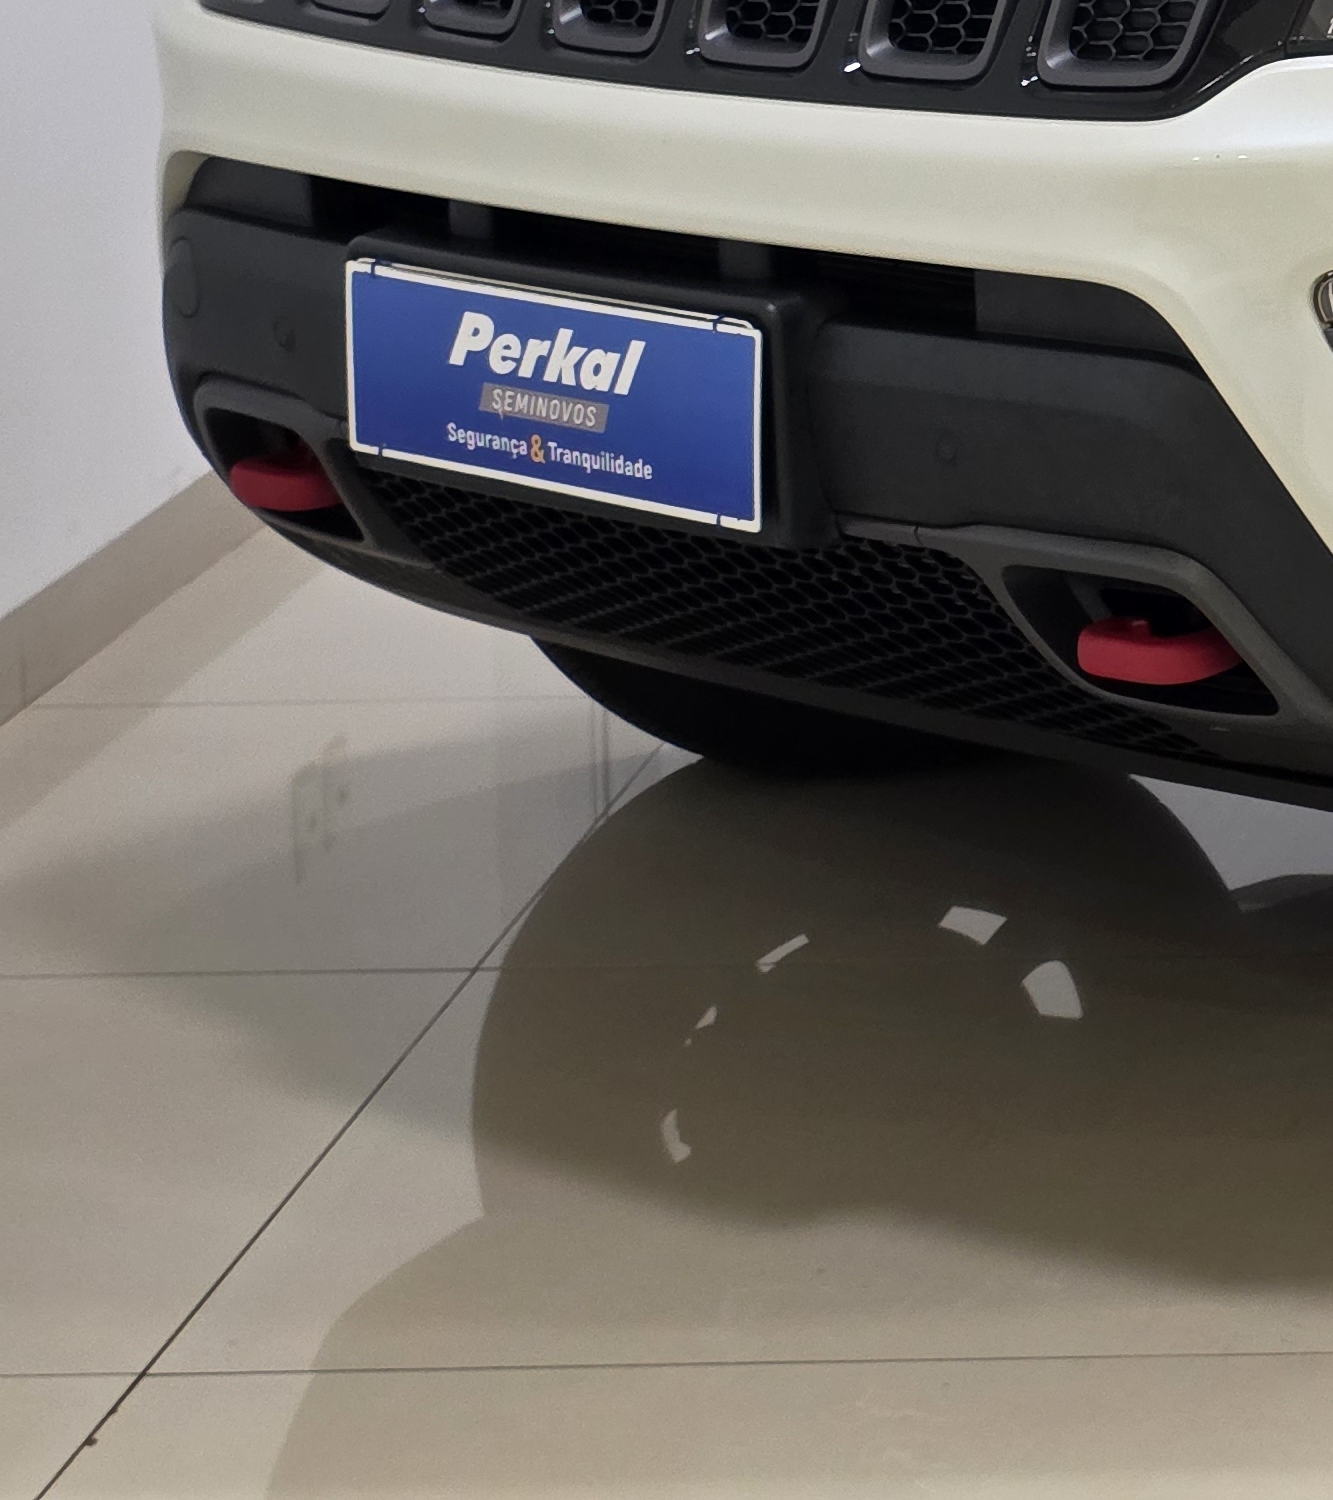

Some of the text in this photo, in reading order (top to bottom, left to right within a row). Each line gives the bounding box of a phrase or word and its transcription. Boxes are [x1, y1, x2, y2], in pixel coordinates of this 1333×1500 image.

[448, 311, 646, 396] Perkal
[491, 388, 597, 427] SEMINOVOS
[447, 422, 653, 481] Segurança & Tranquilidade
